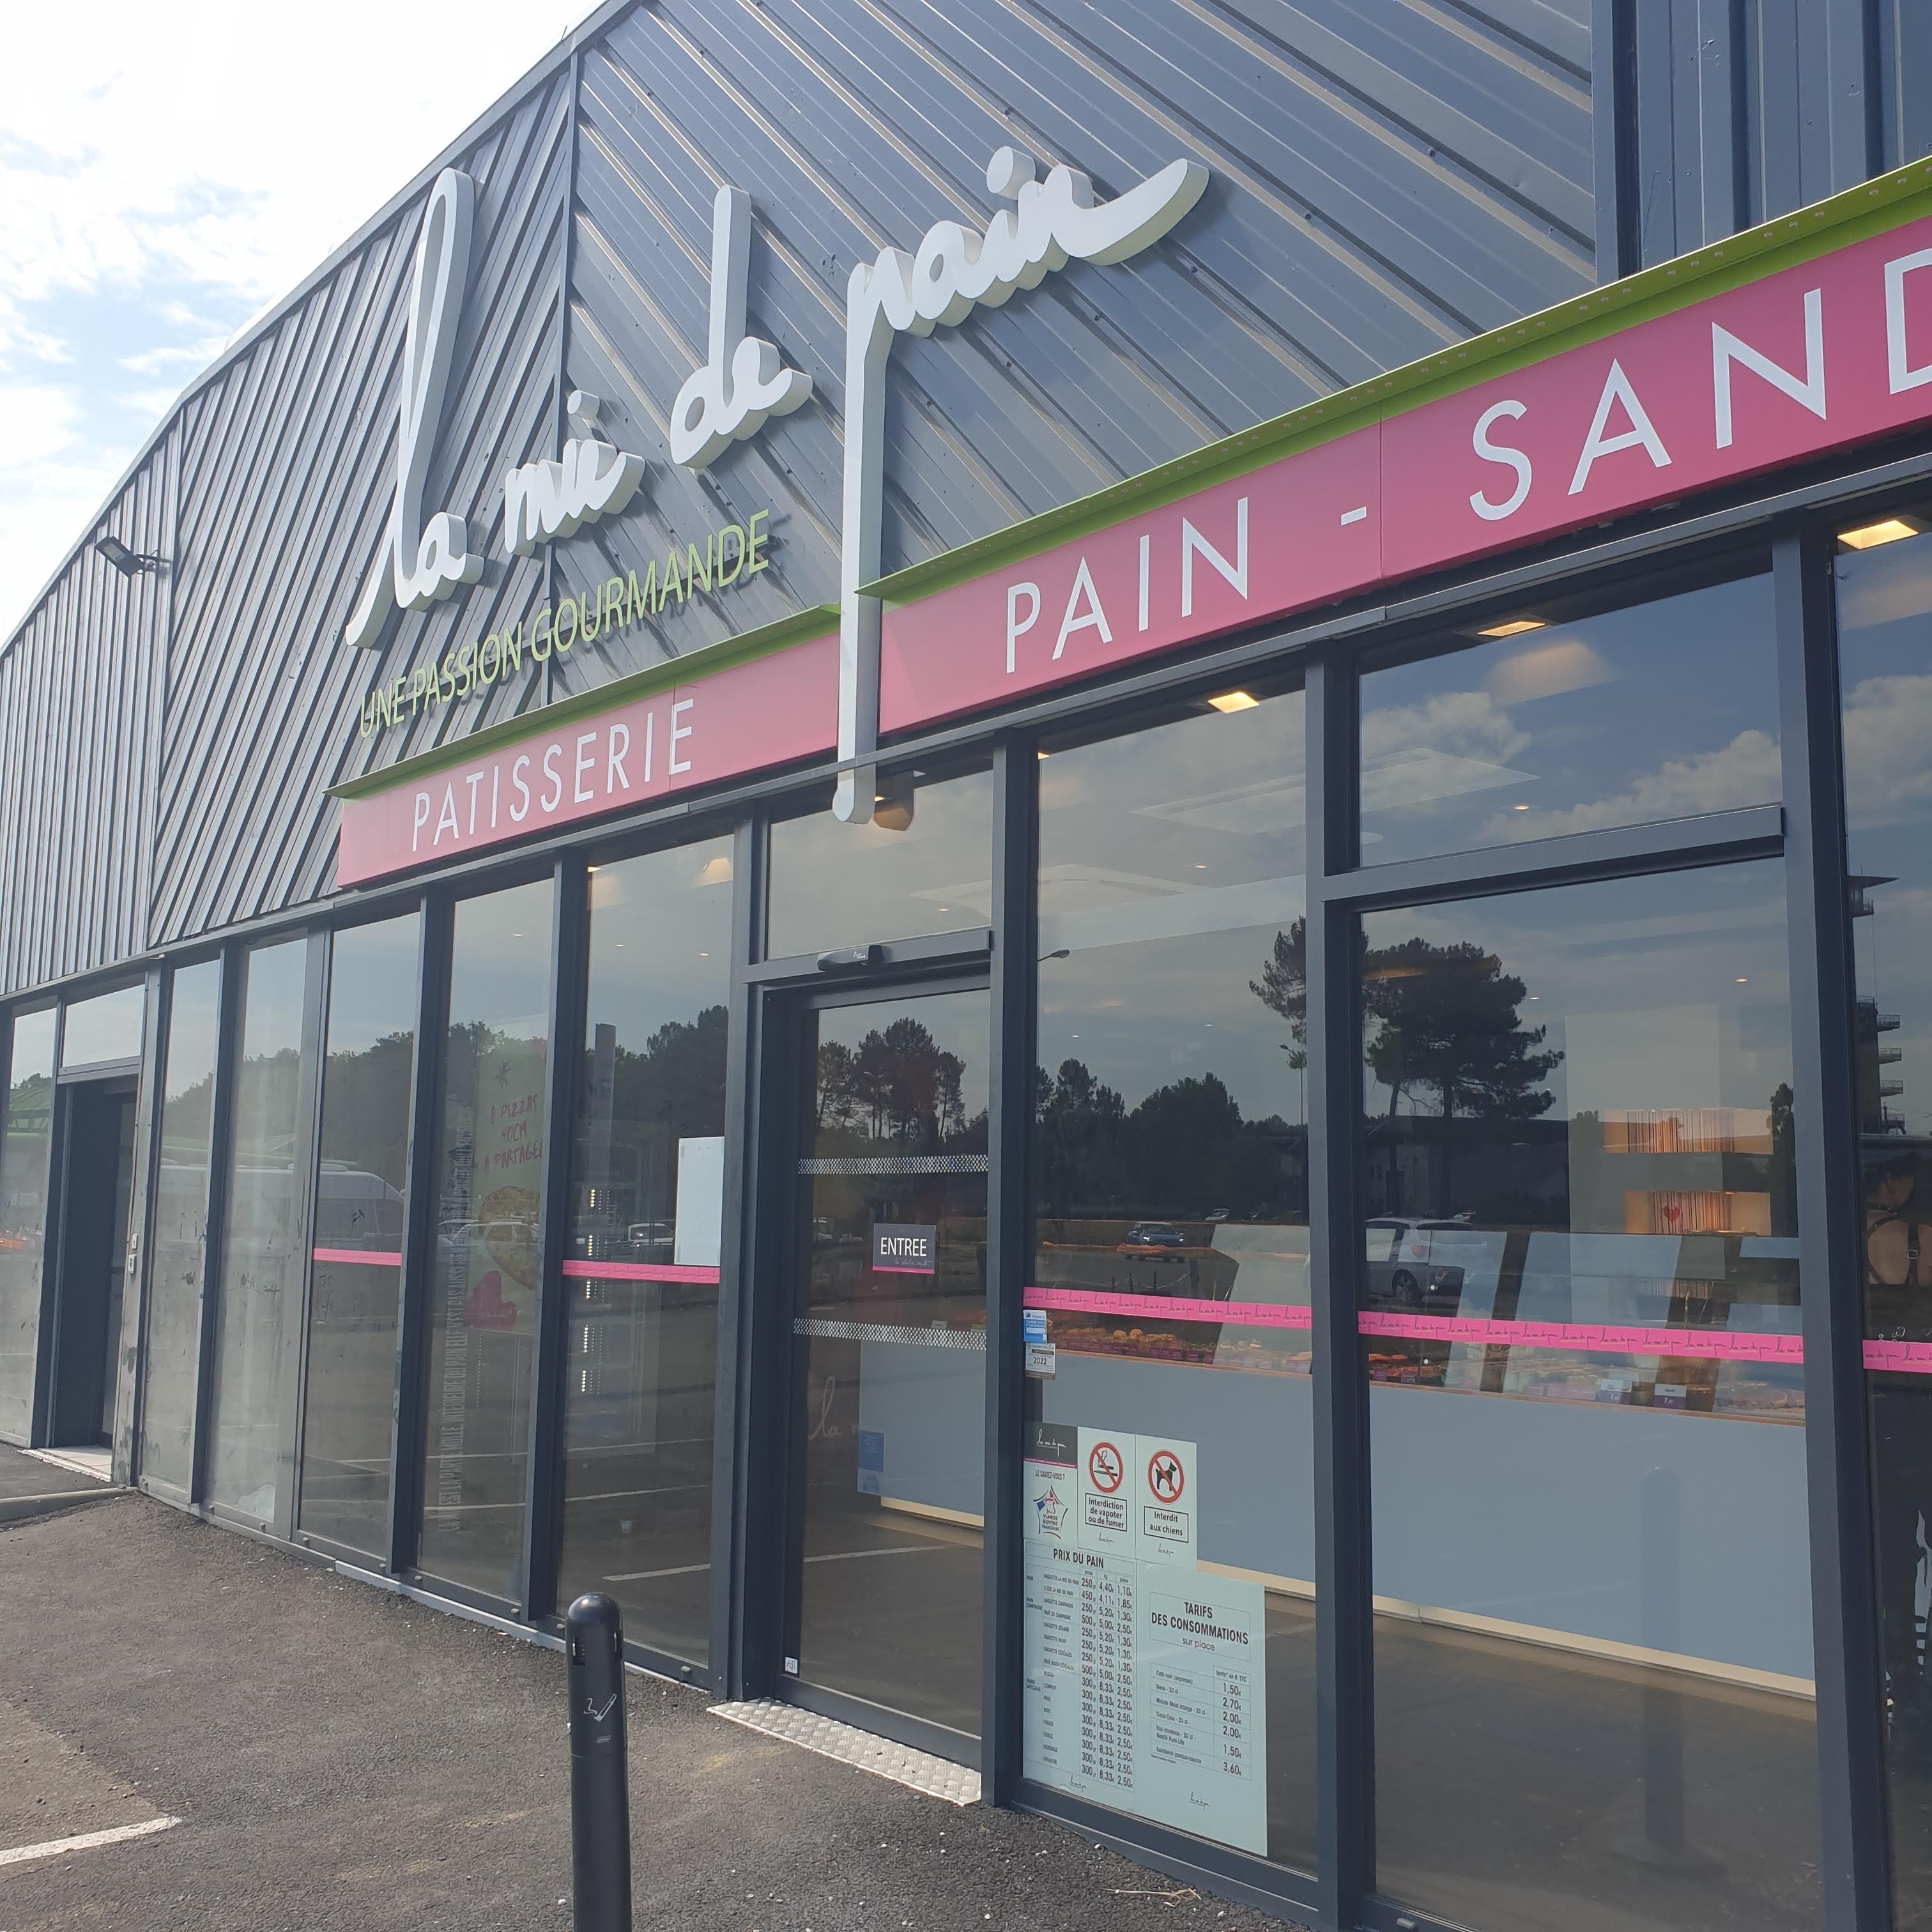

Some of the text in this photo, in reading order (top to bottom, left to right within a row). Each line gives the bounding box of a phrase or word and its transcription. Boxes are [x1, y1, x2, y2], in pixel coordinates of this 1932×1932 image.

[346, 167, 484, 650] la
[670, 184, 813, 469] de
[832, 146, 1209, 825] pain
[1006, 496, 1248, 673] PAIN
[360, 509, 769, 738] UNE PASSION GOURMANDE
[411, 698, 694, 852] PATISSERIE
[880, 1237, 926, 1257] ENTREE
[1033, 1356, 1047, 1365] 2022
[1089, 1498, 1123, 1510] Interdiction
[1099, 1509, 1122, 1519] vapoter
[1106, 1517, 1124, 1528] fumer
[1154, 1511, 1178, 1522] Interdit
[1150, 1523, 1183, 1536] aux chiens
[1054, 1548, 1104, 1568] PRIX DU PAIN
[1184, 1602, 1213, 1619] TARIFS
[1151, 1612, 1248, 1644] DES CONSOMMATIONS
[1183, 1637, 1215, 1651] sur place
